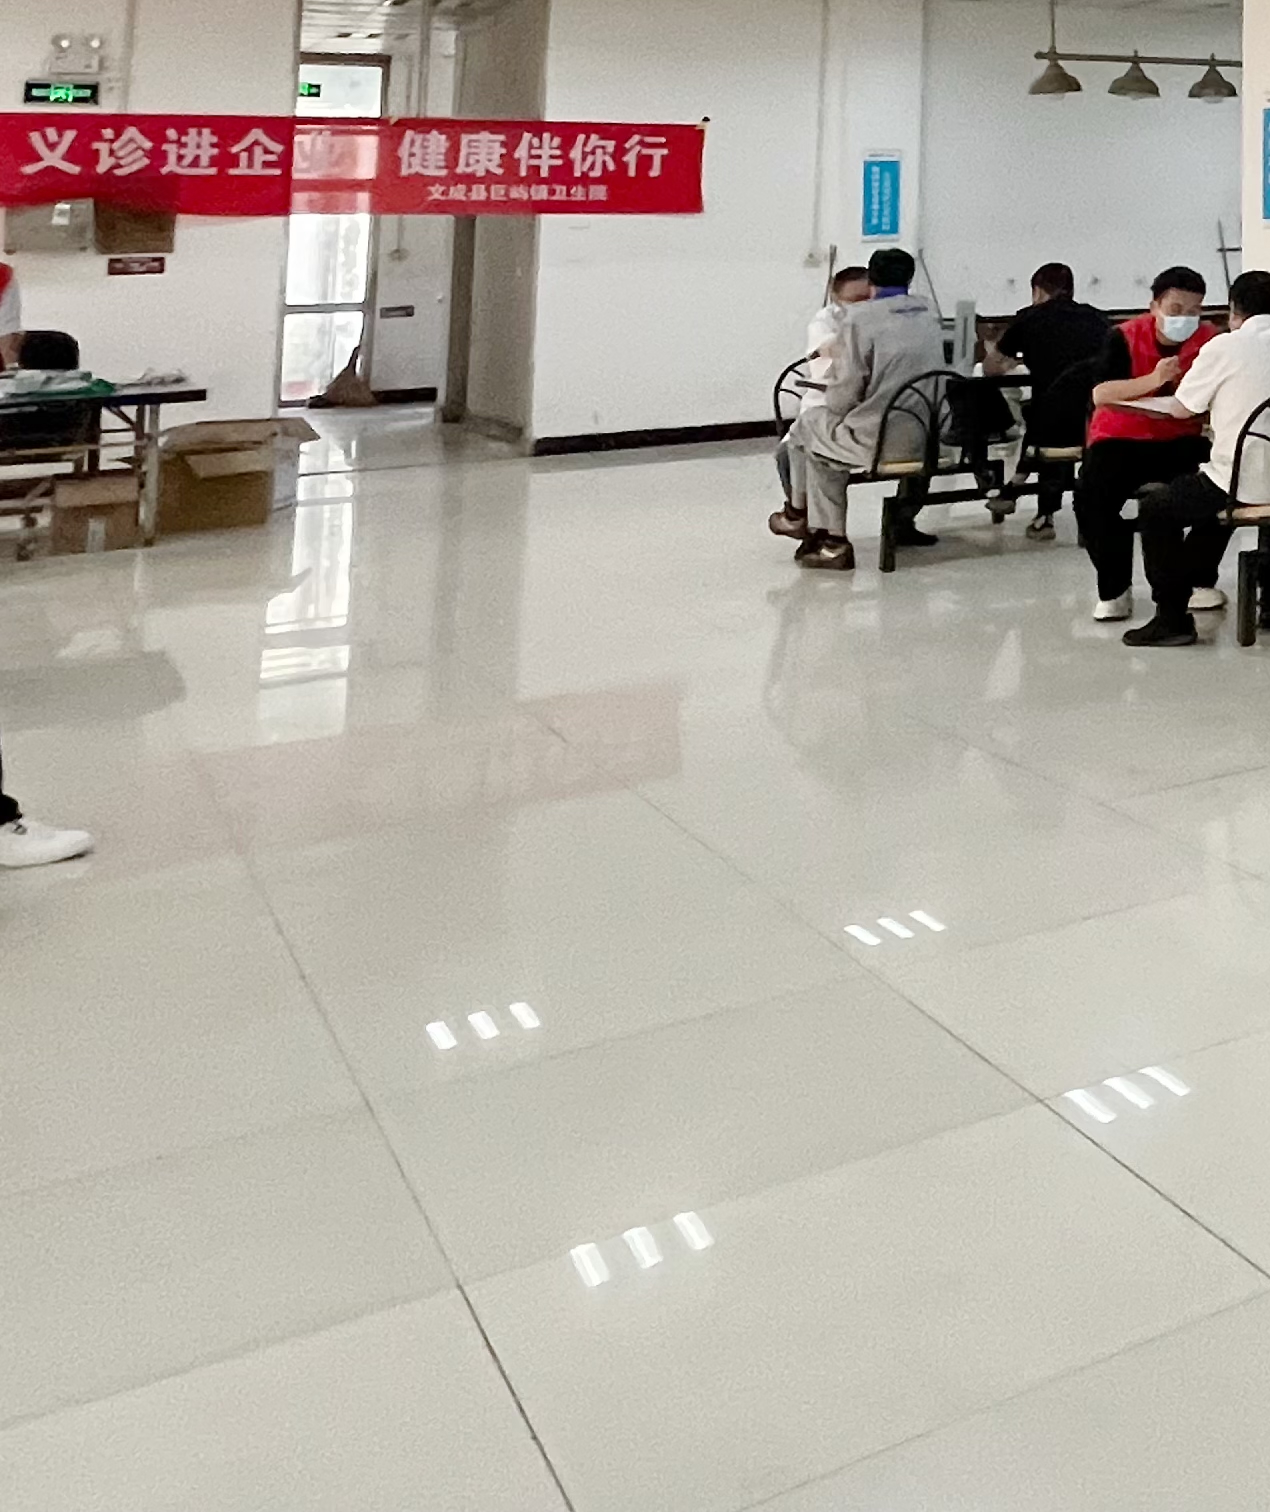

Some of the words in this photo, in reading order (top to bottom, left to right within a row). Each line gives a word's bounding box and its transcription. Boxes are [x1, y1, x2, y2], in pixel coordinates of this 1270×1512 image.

[397, 130, 670, 178] 健康伴你行
